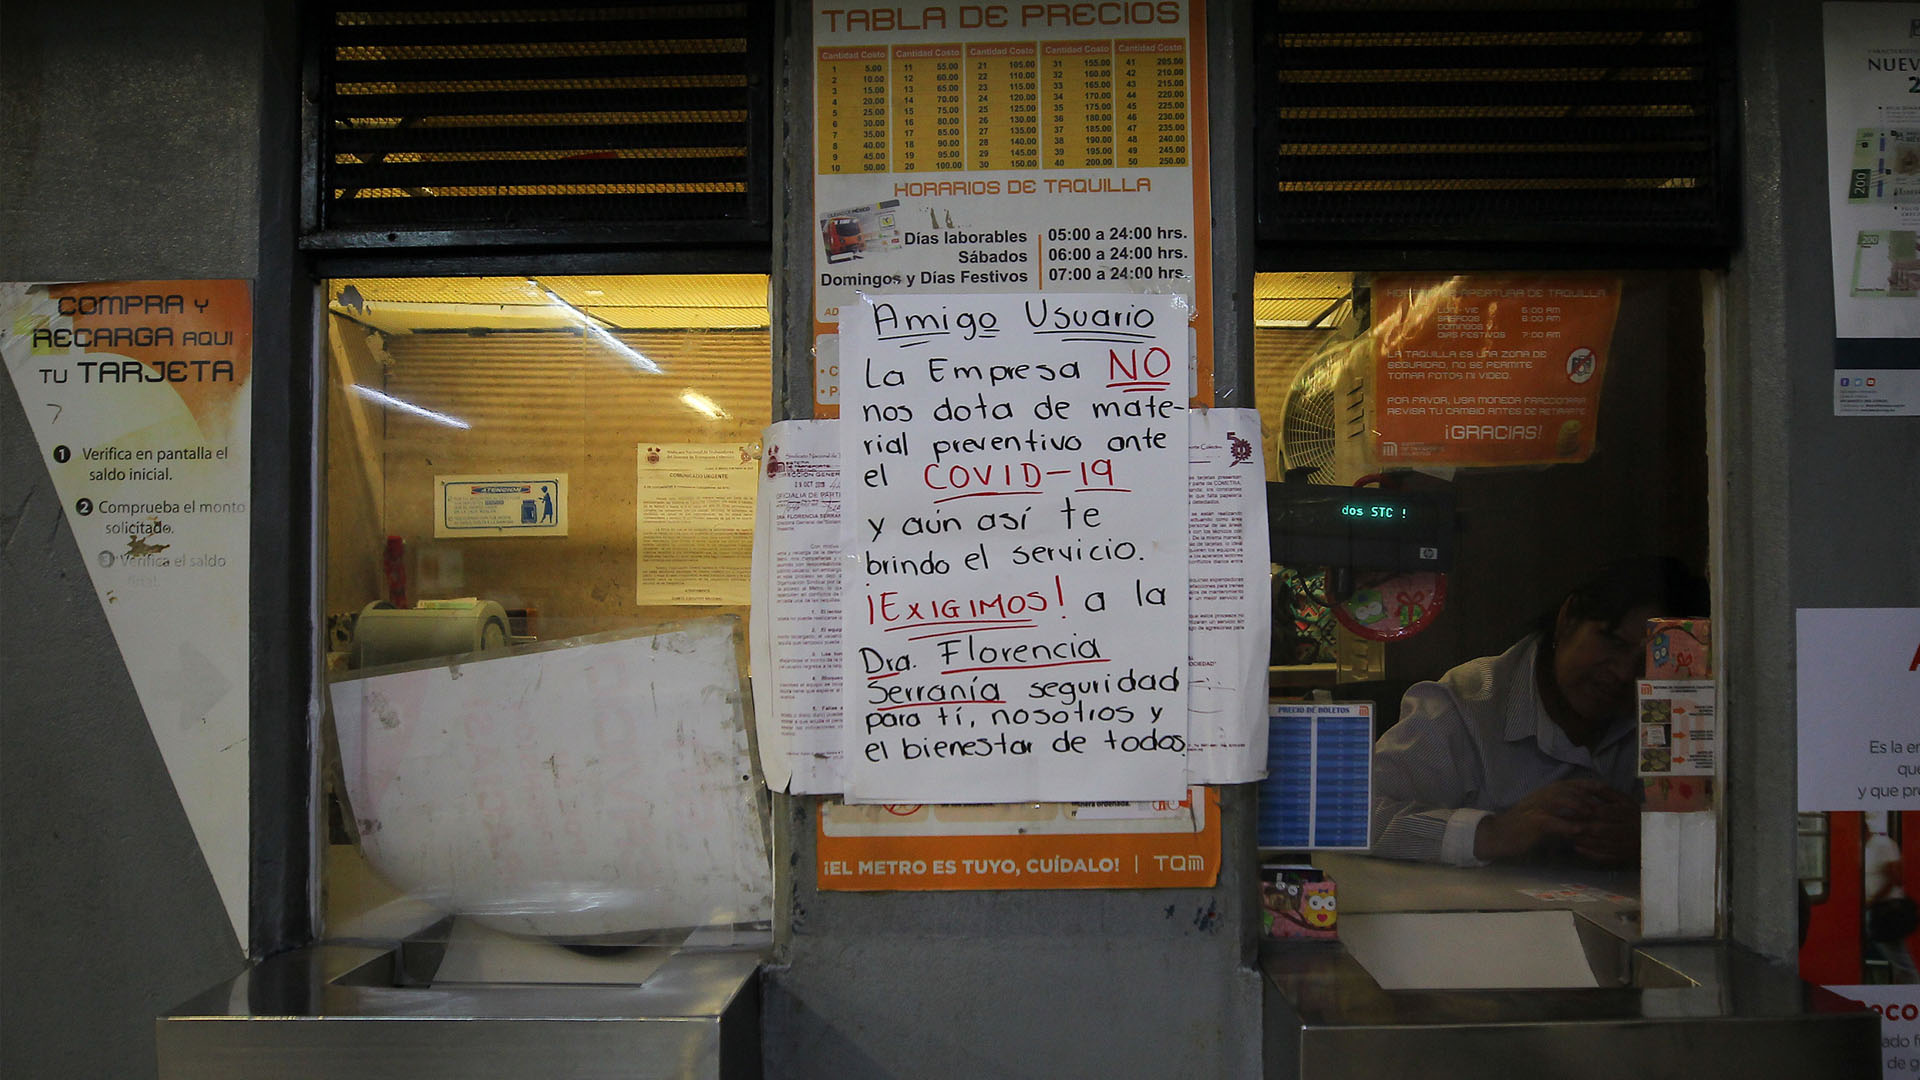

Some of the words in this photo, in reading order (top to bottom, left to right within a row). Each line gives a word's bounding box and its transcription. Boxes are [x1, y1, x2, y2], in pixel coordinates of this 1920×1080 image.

[821, 6, 947, 32] TABLA
[959, 5, 1009, 29] DE
[1021, 1, 1180, 27] PRECIOS
[1118, 44, 1156, 52] Cantidad
[1126, 58, 1135, 66] 41
[1157, 57, 1184, 66] 205.00
[1126, 69, 1136, 77] 42
[1157, 68, 1184, 76] 210.00
[1126, 80, 1136, 88] 43
[1157, 79, 1184, 87] 215.00
[1157, 90, 1184, 98] 220.00
[1127, 102, 1137, 110] 45
[1158, 101, 1185, 109] 225.00
[1127, 113, 1137, 121] 46
[1158, 112, 1185, 120] 230.00
[1127, 124, 1137, 132] 47
[1158, 124, 1185, 132] 235.00
[1127, 135, 1138, 143] 48
[1158, 134, 1185, 143] 240.00
[1159, 146, 1185, 154] 245.00
[1159, 157, 1186, 165] 250.00
[893, 181, 1001, 197] HORARIOS
[1008, 180, 1037, 195] DE
[1043, 177, 1151, 194] TAQUILLA
[1855, 172, 1867, 195] 200
[904, 230, 941, 245] Días
[944, 229, 1028, 245] laborables
[1048, 227, 1092, 243] 05:00
[1095, 231, 1105, 241] a
[1109, 226, 1154, 241] 24:00
[1157, 225, 1188, 240] hrs.
[958, 248, 1028, 265] Sábados
[1048, 248, 1092, 262] 06:00
[1095, 251, 1105, 261] a
[1110, 246, 1154, 261] 24:00
[1157, 246, 1188, 260] hrs.
[821, 271, 902, 289] Domingos
[906, 275, 916, 289] y
[920, 270, 957, 285] Días
[960, 268, 1028, 284] Festivos
[1048, 267, 1092, 282] 07:00
[1095, 271, 1106, 281] a
[1110, 266, 1154, 281] 24:00
[58, 295, 184, 315] COMPRA
[194, 298, 209, 315] Y
[873, 303, 997, 341] Amigo
[1024, 298, 1155, 330] Usuario
[33, 327, 174, 348] RECARGA
[182, 330, 233, 347] AQUI
[1387, 350, 1403, 358] LA
[1404, 350, 1457, 358] TAQUILLA
[1459, 350, 1474, 358] ES
[1501, 350, 1530, 358] ZONA
[1532, 350, 1547, 358] DE
[39, 367, 67, 384] TU
[77, 360, 234, 384] TARJETA
[865, 357, 905, 388] La
[928, 357, 1081, 386] Empresa
[1109, 346, 1171, 381] NO
[1451, 360, 1467, 369] NO
[1469, 360, 1483, 369] SE
[1485, 360, 1533, 369] PERMITE
[1387, 371, 1426, 381] TOMAR
[1427, 371, 1464, 381] FOTOS
[1466, 371, 1476, 381] NI
[862, 401, 913, 423] nos
[933, 392, 1013, 422] dota
[1033, 394, 1070, 420] de
[1092, 394, 1186, 419] mate-
[1387, 396, 1409, 405] POR
[1453, 396, 1476, 405] USA
[1478, 396, 1522, 405] MONEDA
[1387, 407, 1426, 416] REVISA
[1429, 407, 1443, 416] TU
[1445, 407, 1486, 416] CAMBIO
[1488, 407, 1522, 416] ANTES
[1524, 407, 1537, 416] DE
[1444, 424, 1543, 441] ¡GRACIAS!
[863, 431, 909, 457] rial
[932, 427, 1083, 464] preventivo
[1107, 426, 1168, 453] ante
[82, 447, 132, 461] Verifica
[136, 450, 153, 460] en
[157, 447, 212, 463] pantalla
[216, 446, 228, 460] el
[89, 469, 125, 481] saldo
[129, 468, 173, 481] inicial.
[863, 462, 887, 489] el
[923, 458, 1116, 490] COVID-19
[98, 500, 180, 516] Comprueba
[184, 500, 196, 513] el
[199, 502, 246, 513] monto
[1341, 504, 1364, 517] dos
[1371, 506, 1394, 518] STC
[868, 515, 886, 543] y
[901, 508, 962, 536] aún
[976, 506, 1033, 532] así
[1060, 496, 1100, 530] te
[105, 521, 174, 535] solicitado.
[174, 554, 186, 567] el
[190, 554, 227, 568] saldo
[865, 548, 951, 578] brindo
[964, 542, 987, 572] el
[1012, 537, 1145, 565] servicio.
[865, 574, 1067, 626] ¡EXIGIMOS!
[1084, 589, 1106, 613] a
[1135, 578, 1167, 608] la
[858, 646, 917, 676] Dra.
[937, 632, 1102, 666] Florencia
[868, 675, 1001, 705] Serranía
[1028, 665, 1180, 706] seguridad
[865, 711, 921, 735] para
[937, 706, 975, 729] tí,
[991, 699, 1135, 727] nosotros
[1150, 705, 1164, 725] y
[1278, 706, 1305, 714] PRECIO
[1305, 706, 1317, 714] DE
[1317, 706, 1350, 714] BOLETOS
[864, 740, 888, 763] el
[902, 731, 1034, 761] bienestar
[1051, 729, 1087, 755] de
[1103, 727, 1186, 758] todos.
[1870, 740, 1888, 754] Es
[1891, 740, 1903, 754] la
[1858, 786, 1867, 800] y
[1870, 786, 1899, 799] que
[823, 859, 853, 878] ¡EL
[858, 858, 928, 876] METRO
[932, 858, 957, 875] ES
[960, 857, 1021, 878] TUYO,
[1025, 853, 1121, 874] CUÍDALO!
